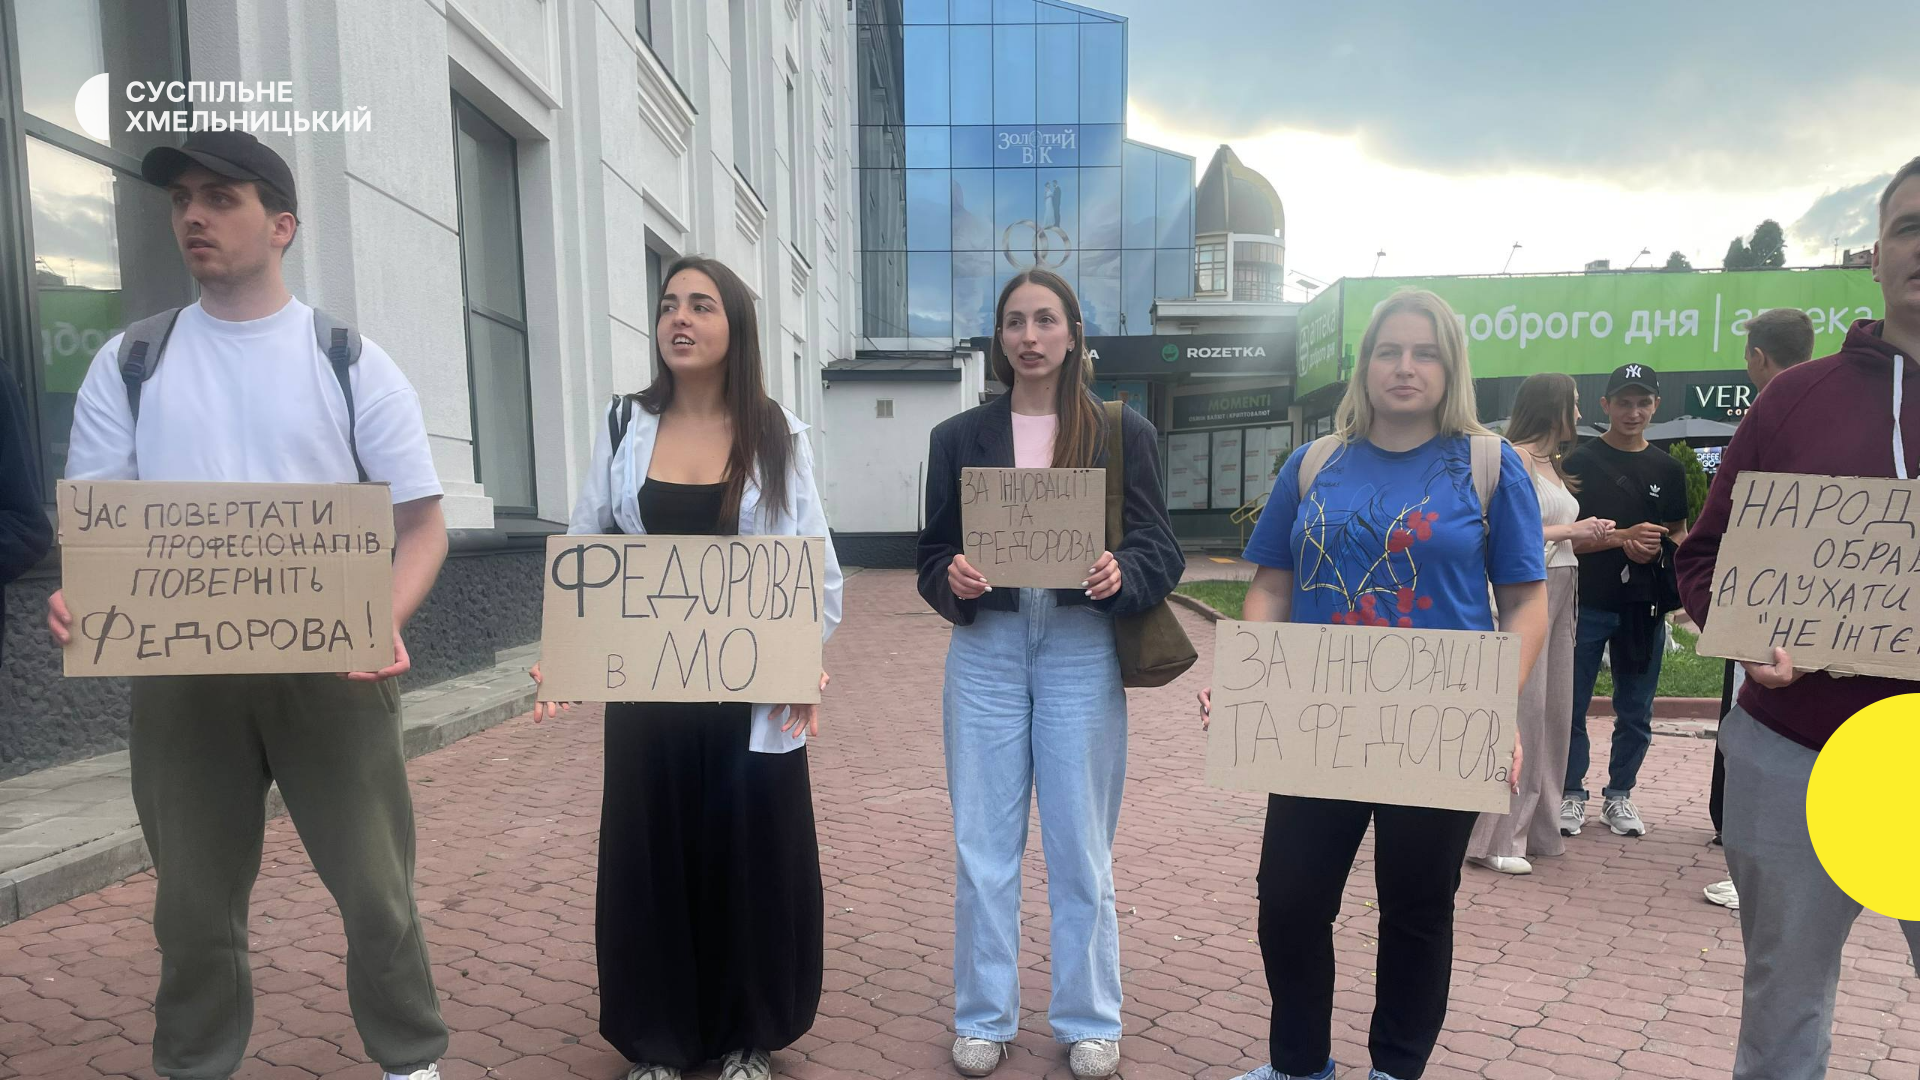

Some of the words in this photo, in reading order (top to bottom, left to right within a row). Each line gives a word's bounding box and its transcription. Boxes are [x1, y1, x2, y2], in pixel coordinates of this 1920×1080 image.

[1624, 309, 1699, 345] дня
[1186, 346, 1266, 359] ROZETKA
[964, 472, 989, 504] ЗА
[144, 500, 333, 530] ПОВЕРТАТИ
[1002, 504, 1034, 526] ТА
[1736, 480, 1915, 539] НАРОД
[147, 525, 381, 558] ПРОФЕСІОНАЛІВ
[966, 530, 1096, 564] ФЕДОРОВА
[131, 559, 323, 598] ПОВЕРНІТЬ
[551, 540, 818, 622] ФЕДОРОВА
[1717, 566, 1738, 607] А
[1747, 568, 1911, 613] СЛУХАТИ
[652, 628, 758, 692] МО
[1222, 630, 1291, 691] ЗА
[1225, 701, 1283, 767] ТА
